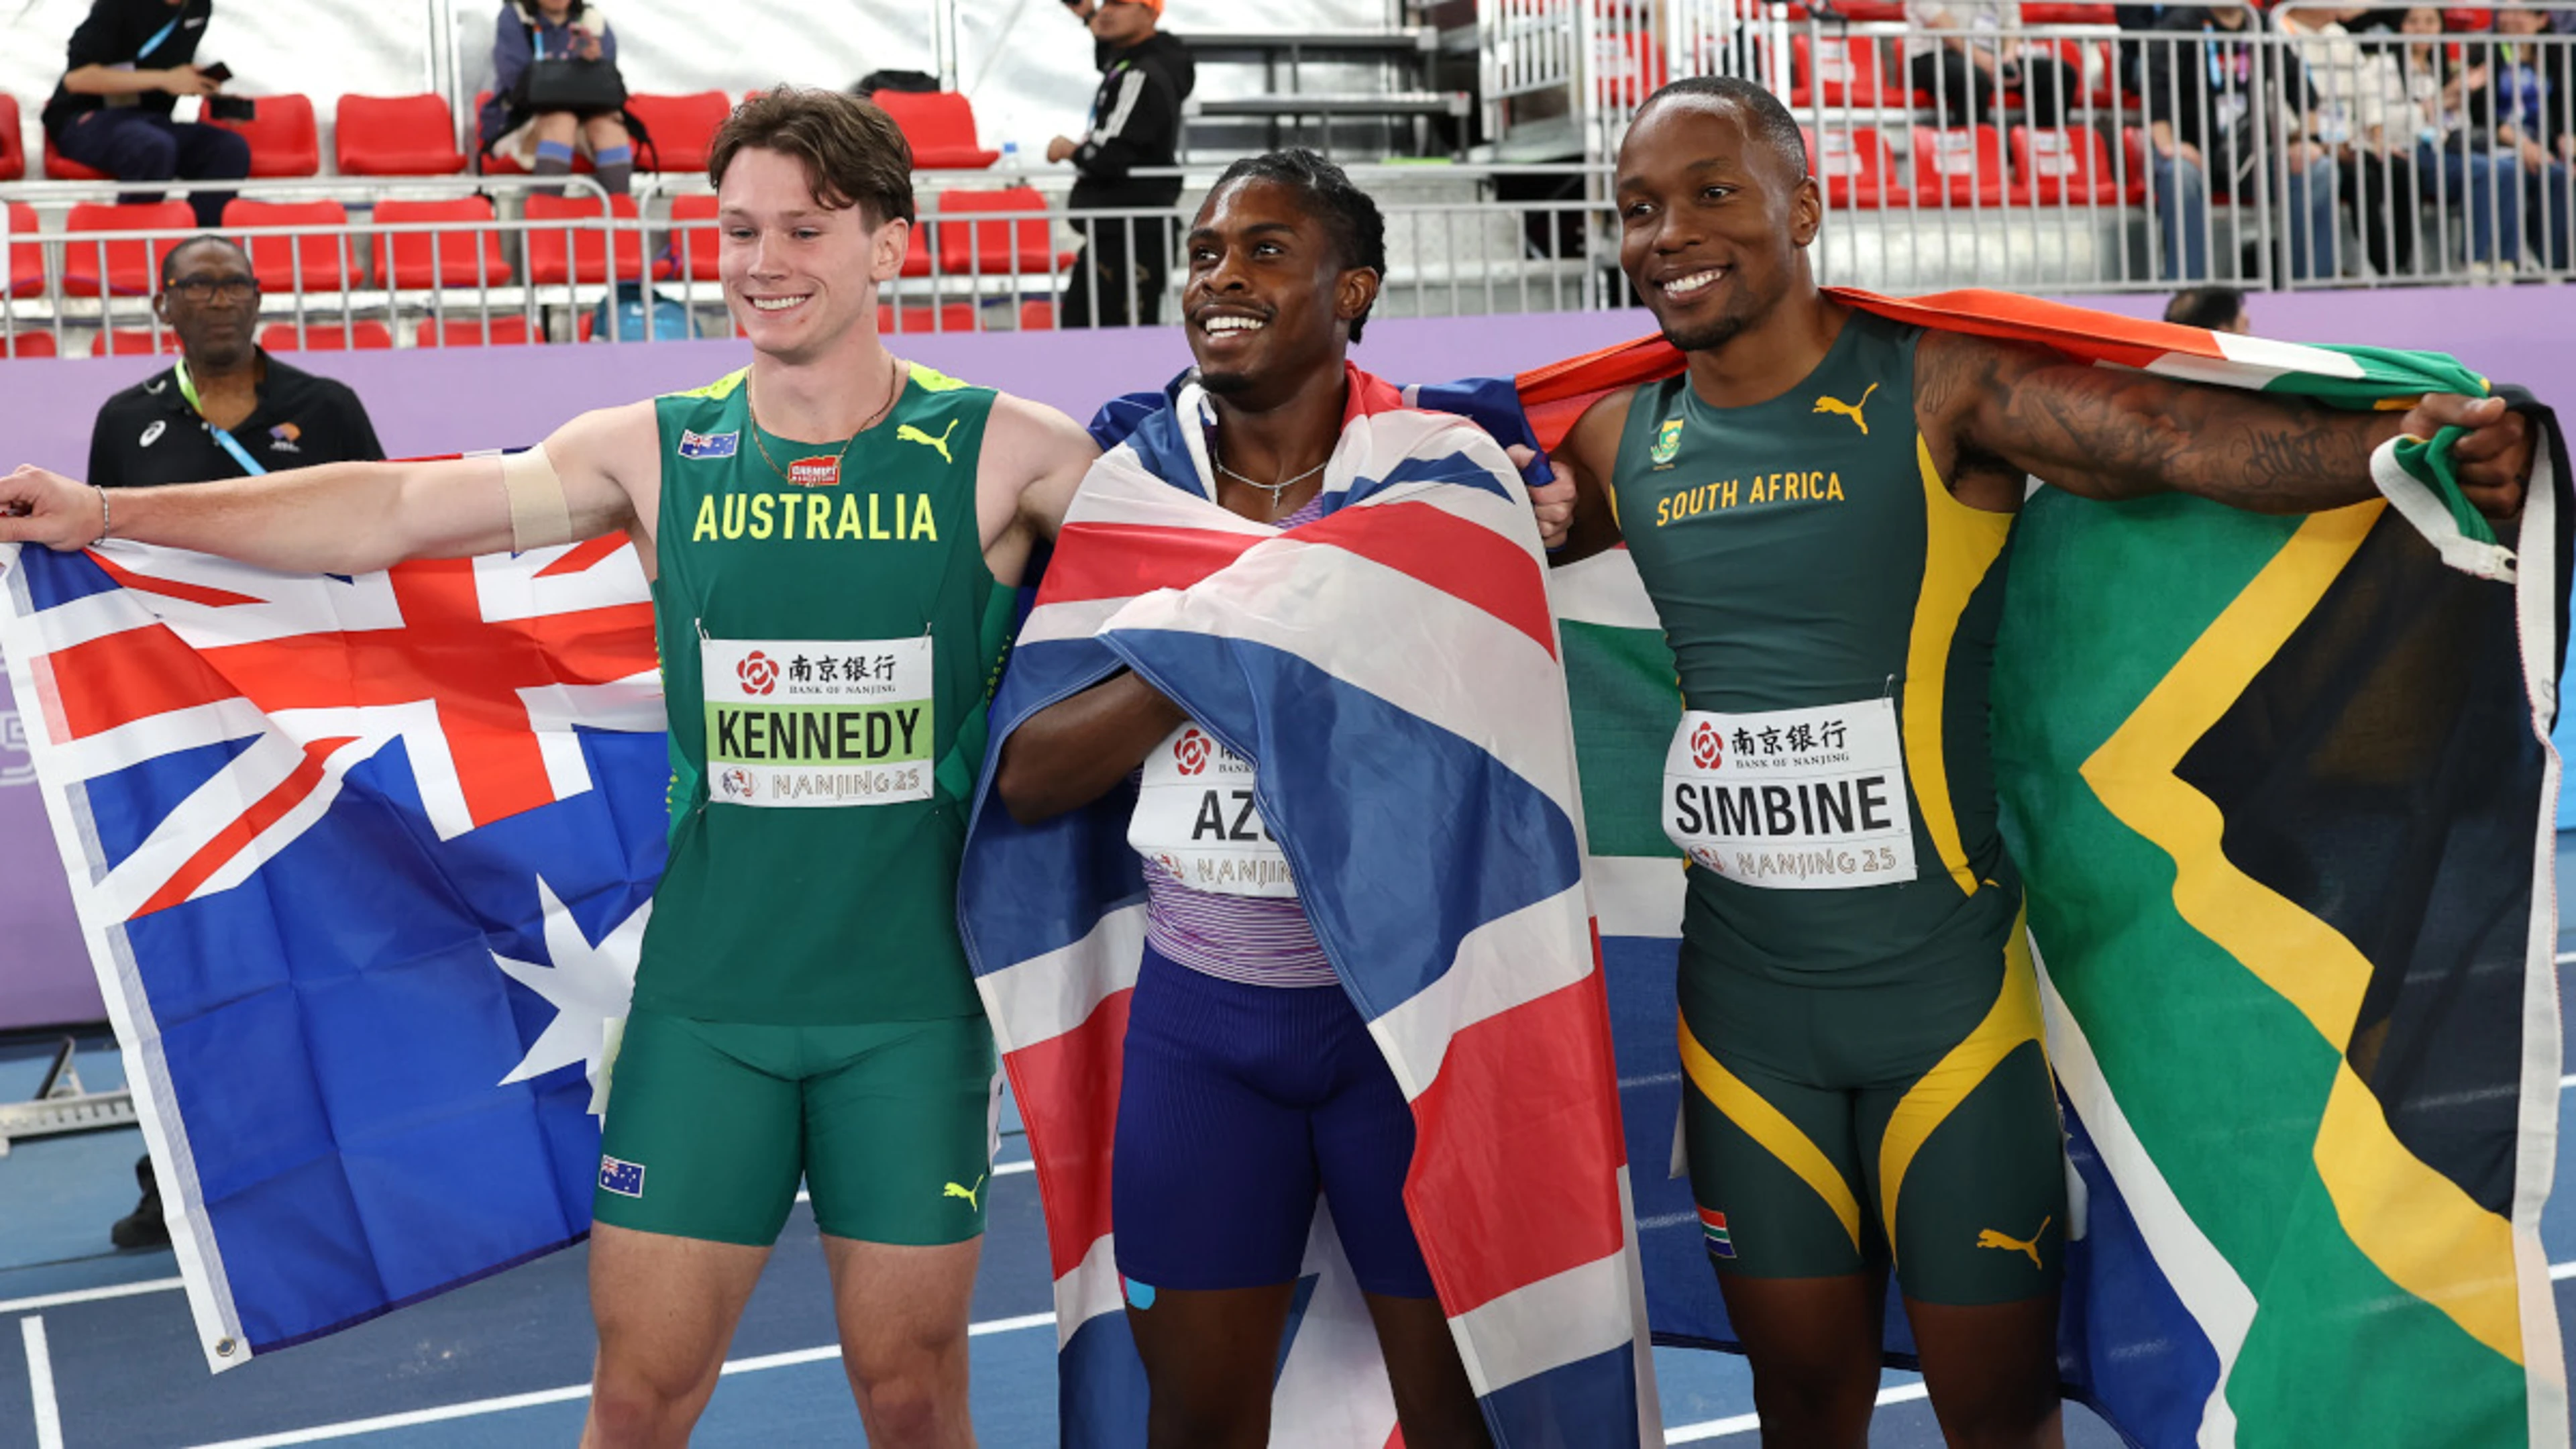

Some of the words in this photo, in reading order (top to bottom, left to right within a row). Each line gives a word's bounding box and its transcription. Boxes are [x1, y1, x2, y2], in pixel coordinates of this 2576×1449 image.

[692, 493, 938, 542] AUSTRALIA
[1656, 478, 1739, 527] SOUTH
[1749, 471, 1845, 504] AFRICA
[789, 654, 896, 683] 南京银行
[790, 685, 822, 694] BANK
[826, 685, 841, 694] OF
[845, 684, 896, 696] NANJING
[718, 708, 920, 759] KENNEDY
[1731, 719, 1848, 757] 南京银行
[1735, 759, 1768, 769] BANK
[1772, 758, 1788, 767] OF
[1792, 751, 1849, 767] NANJING
[773, 770, 890, 800] NANJING
[893, 768, 920, 791] 25
[1191, 790, 1277, 842] AZ
[1676, 775, 1892, 837] SIMBINE
[1736, 847, 1856, 880] NANJING
[1862, 847, 1897, 873] 25
